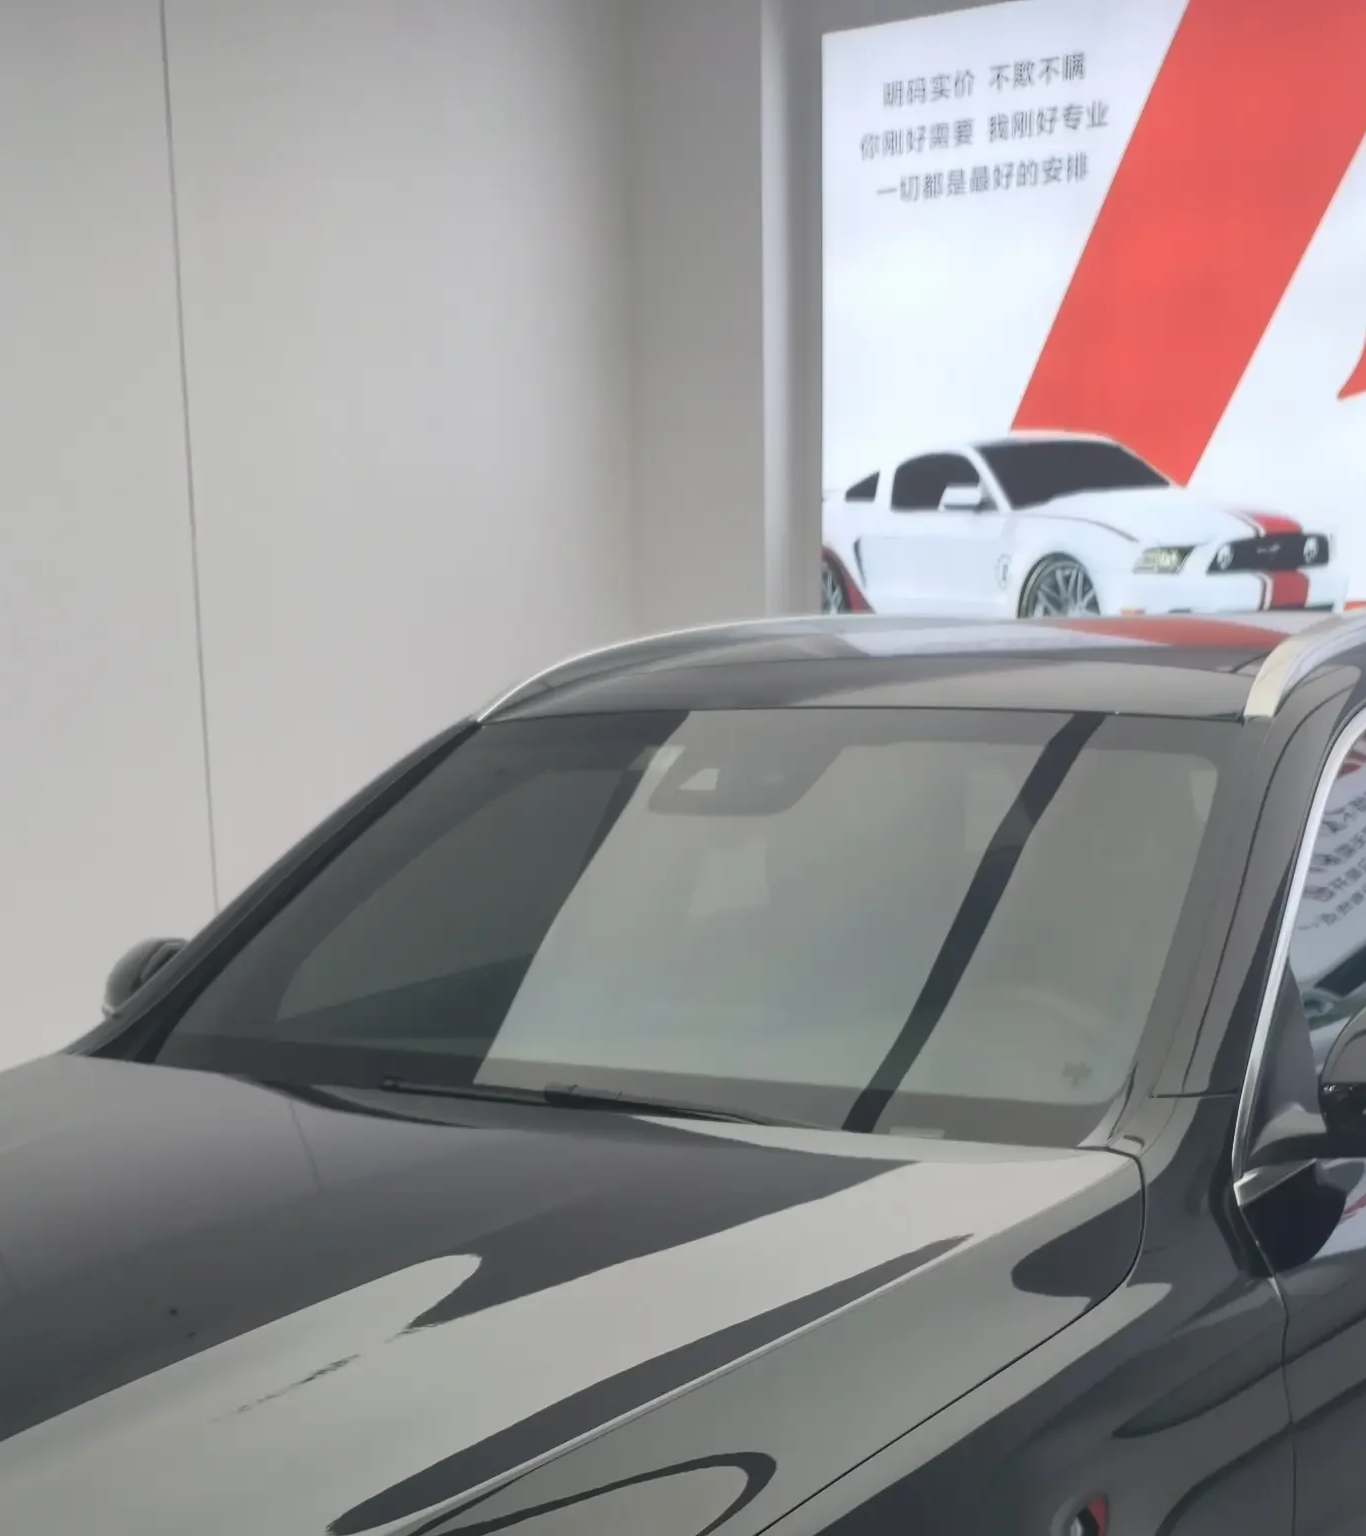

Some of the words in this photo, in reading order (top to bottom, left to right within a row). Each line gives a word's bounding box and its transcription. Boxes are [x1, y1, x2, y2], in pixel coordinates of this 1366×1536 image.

[883, 68, 976, 108] 明码实价
[988, 51, 1086, 91] 不欺不瞒
[859, 117, 975, 162] 你刚好需要
[987, 99, 1110, 144] 我刚好专业
[876, 150, 1089, 203] 一切都是最好的安排
